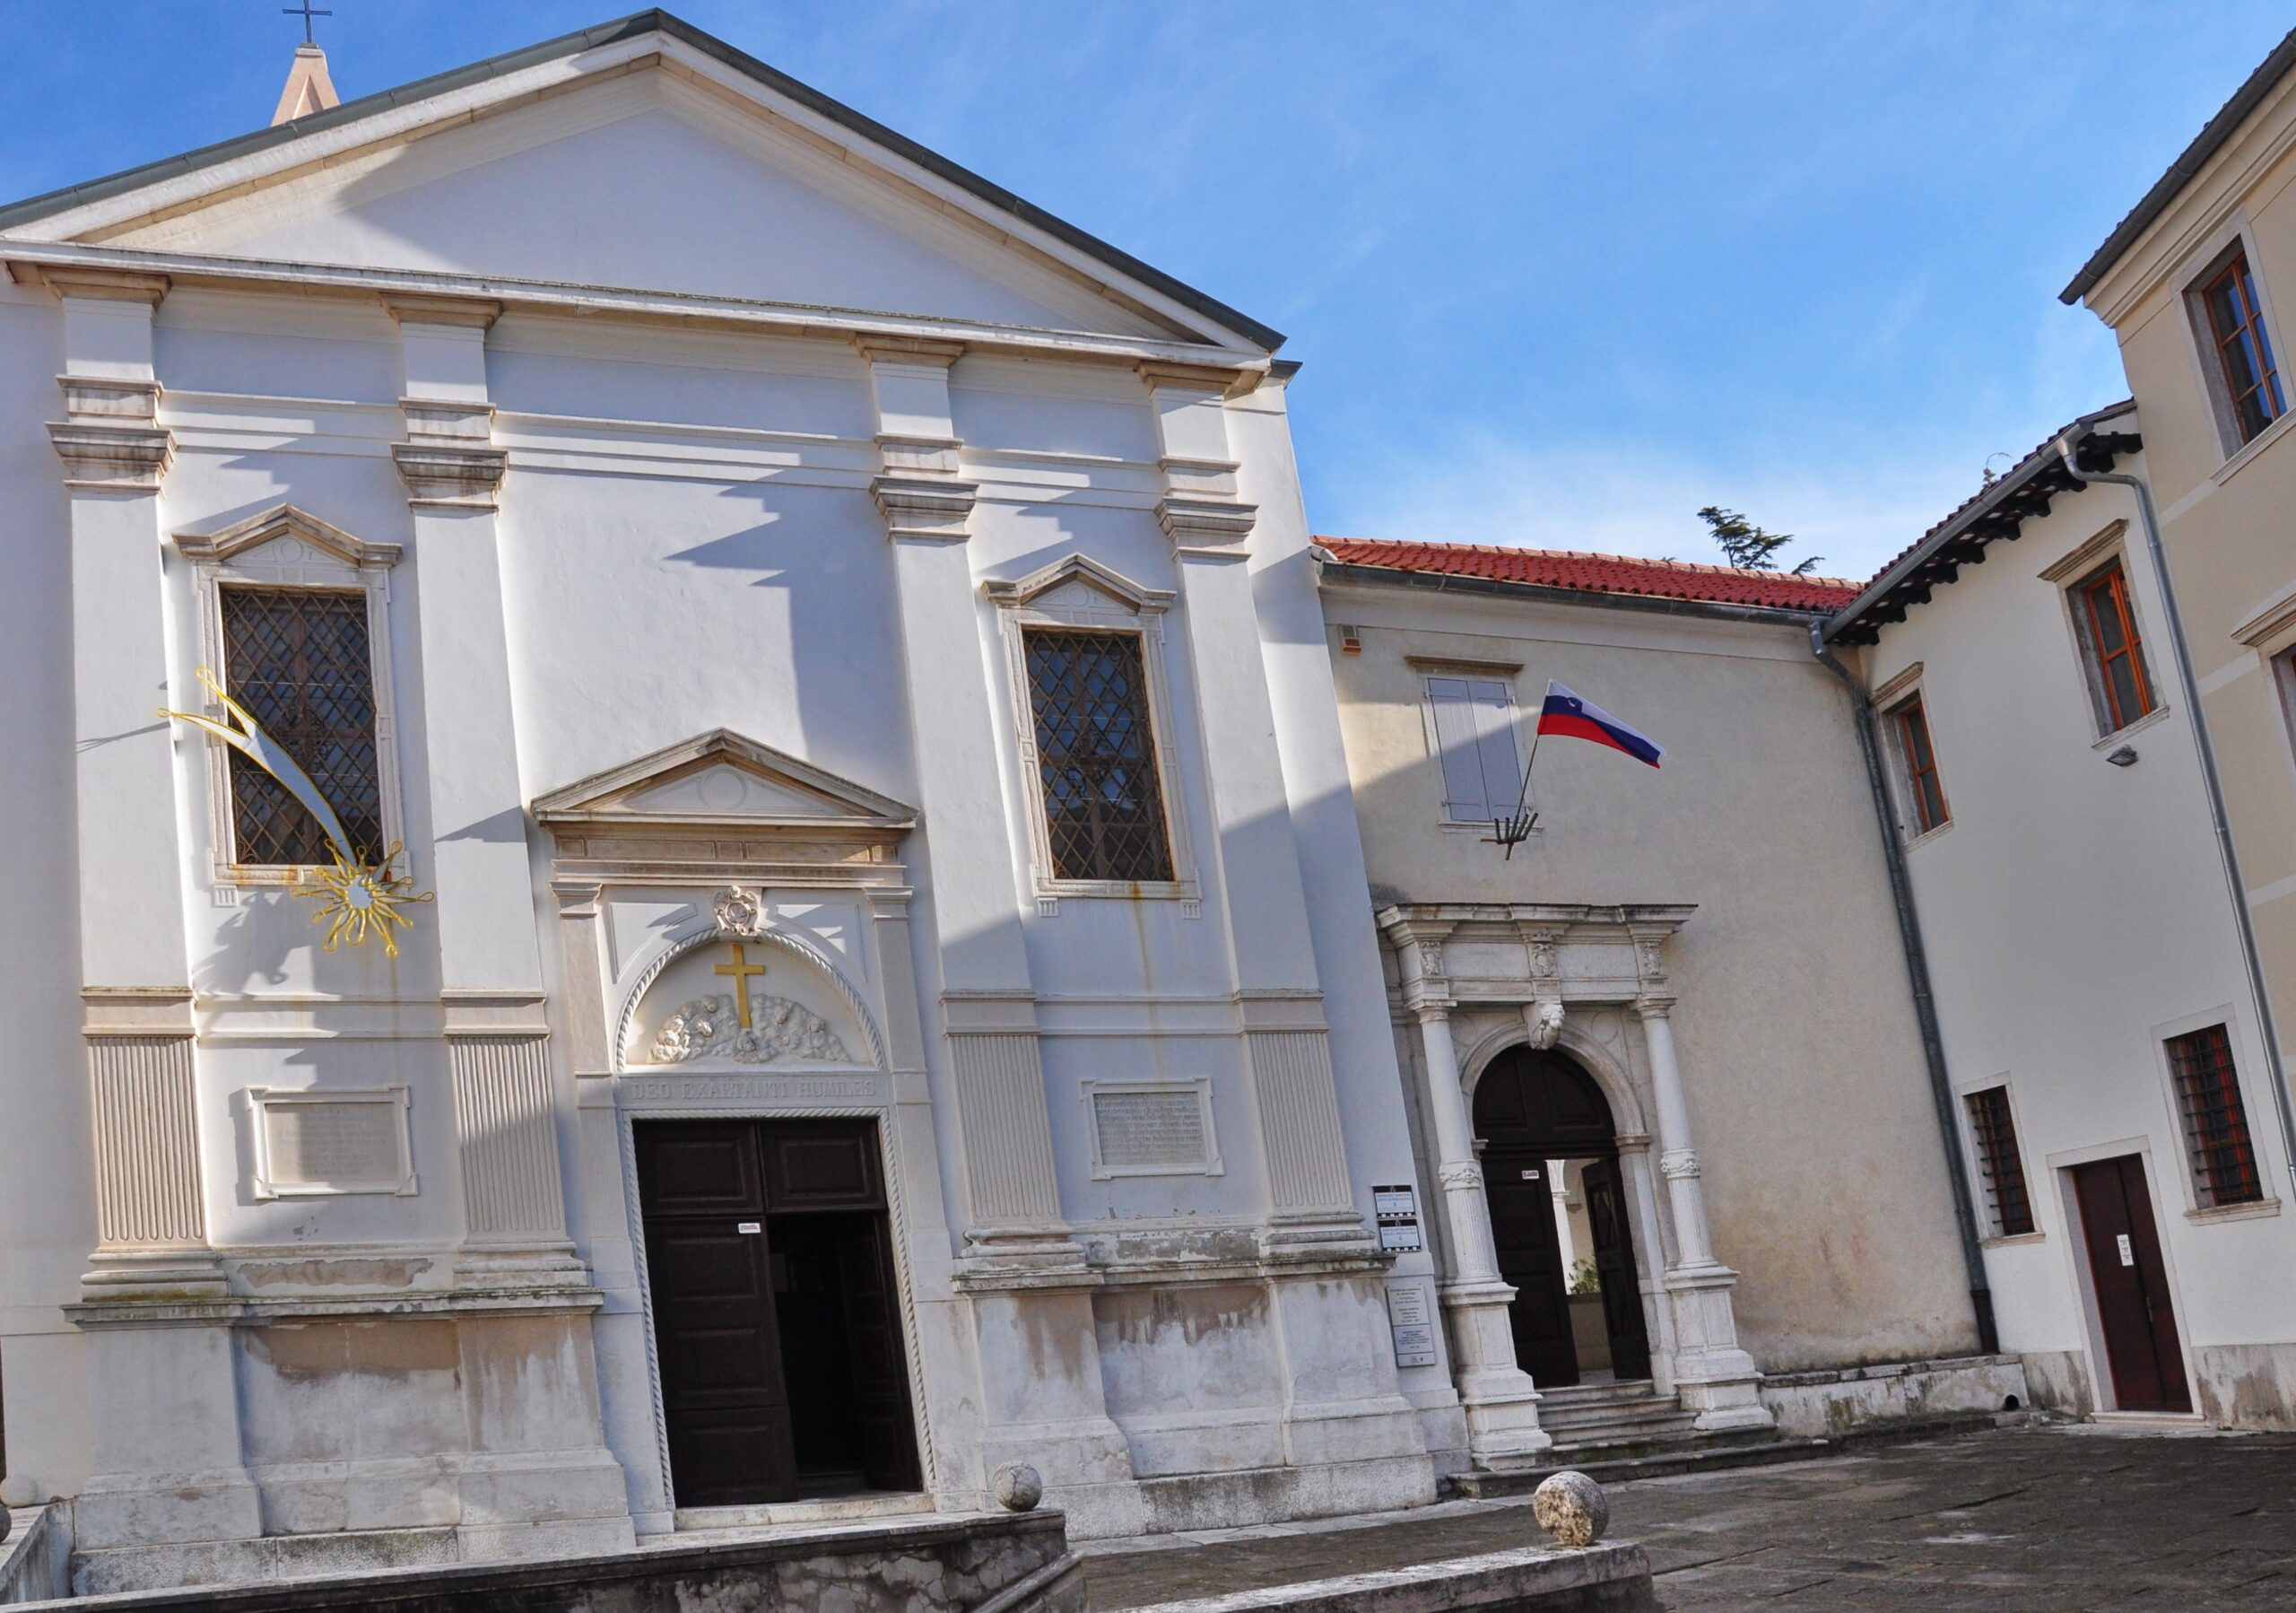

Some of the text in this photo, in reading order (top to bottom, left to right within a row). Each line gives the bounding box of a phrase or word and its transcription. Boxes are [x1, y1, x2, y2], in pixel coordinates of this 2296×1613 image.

[631, 1080, 876, 1100] DEO EXALTANTI HUMILES
